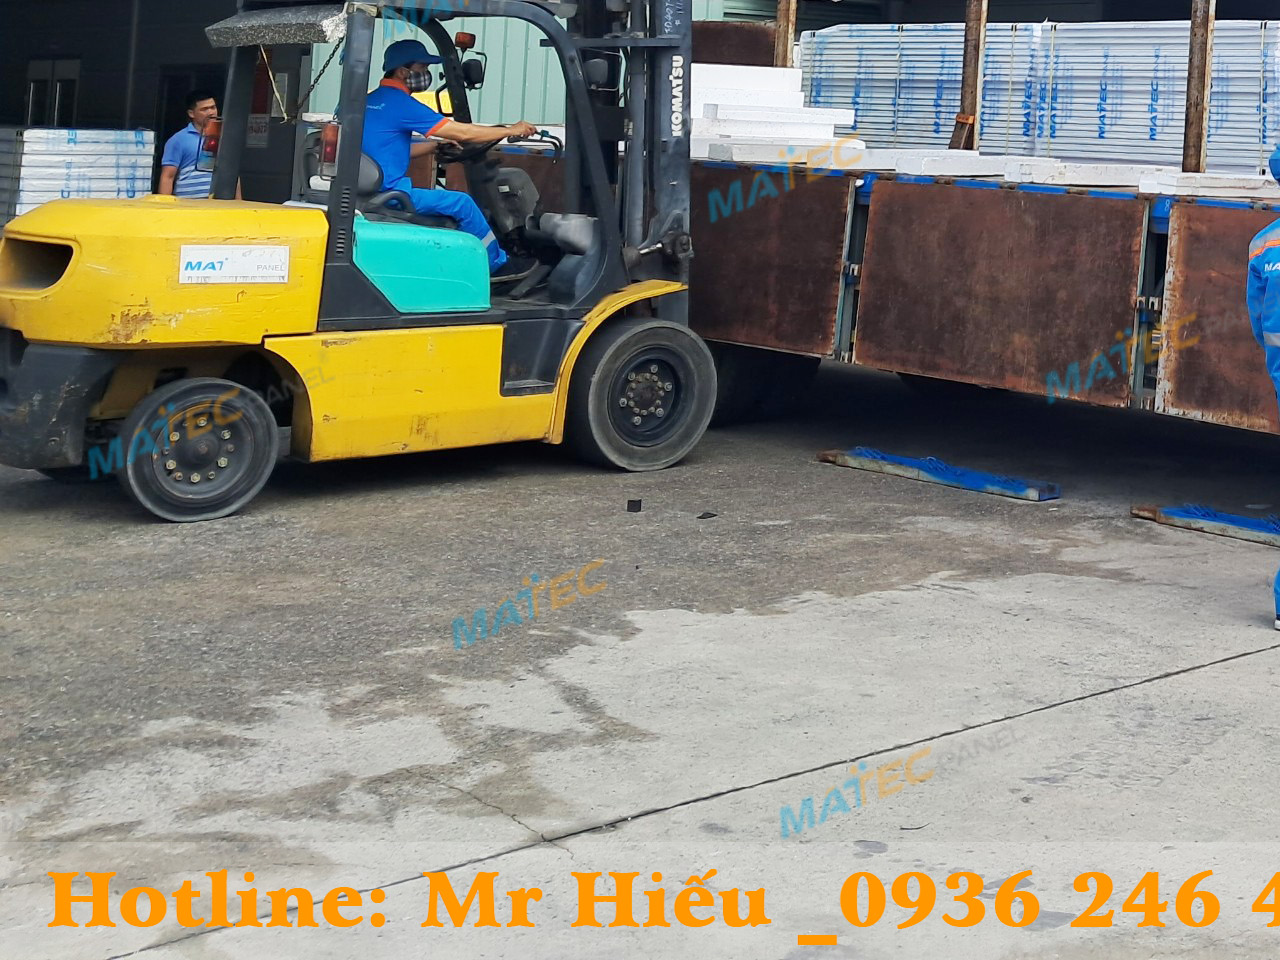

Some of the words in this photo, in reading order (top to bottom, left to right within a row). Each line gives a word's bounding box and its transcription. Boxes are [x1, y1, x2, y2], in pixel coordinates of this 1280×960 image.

[669, 55, 684, 137] KOMATSU
[1023, 79, 1033, 137] MATEC
[1036, 81, 1047, 139] MATEC
[1050, 82, 1059, 139] MATEC
[1097, 81, 1108, 139] MATEC
[1148, 79, 1159, 141] MATEC
[256, 264, 285, 272] PANEL
